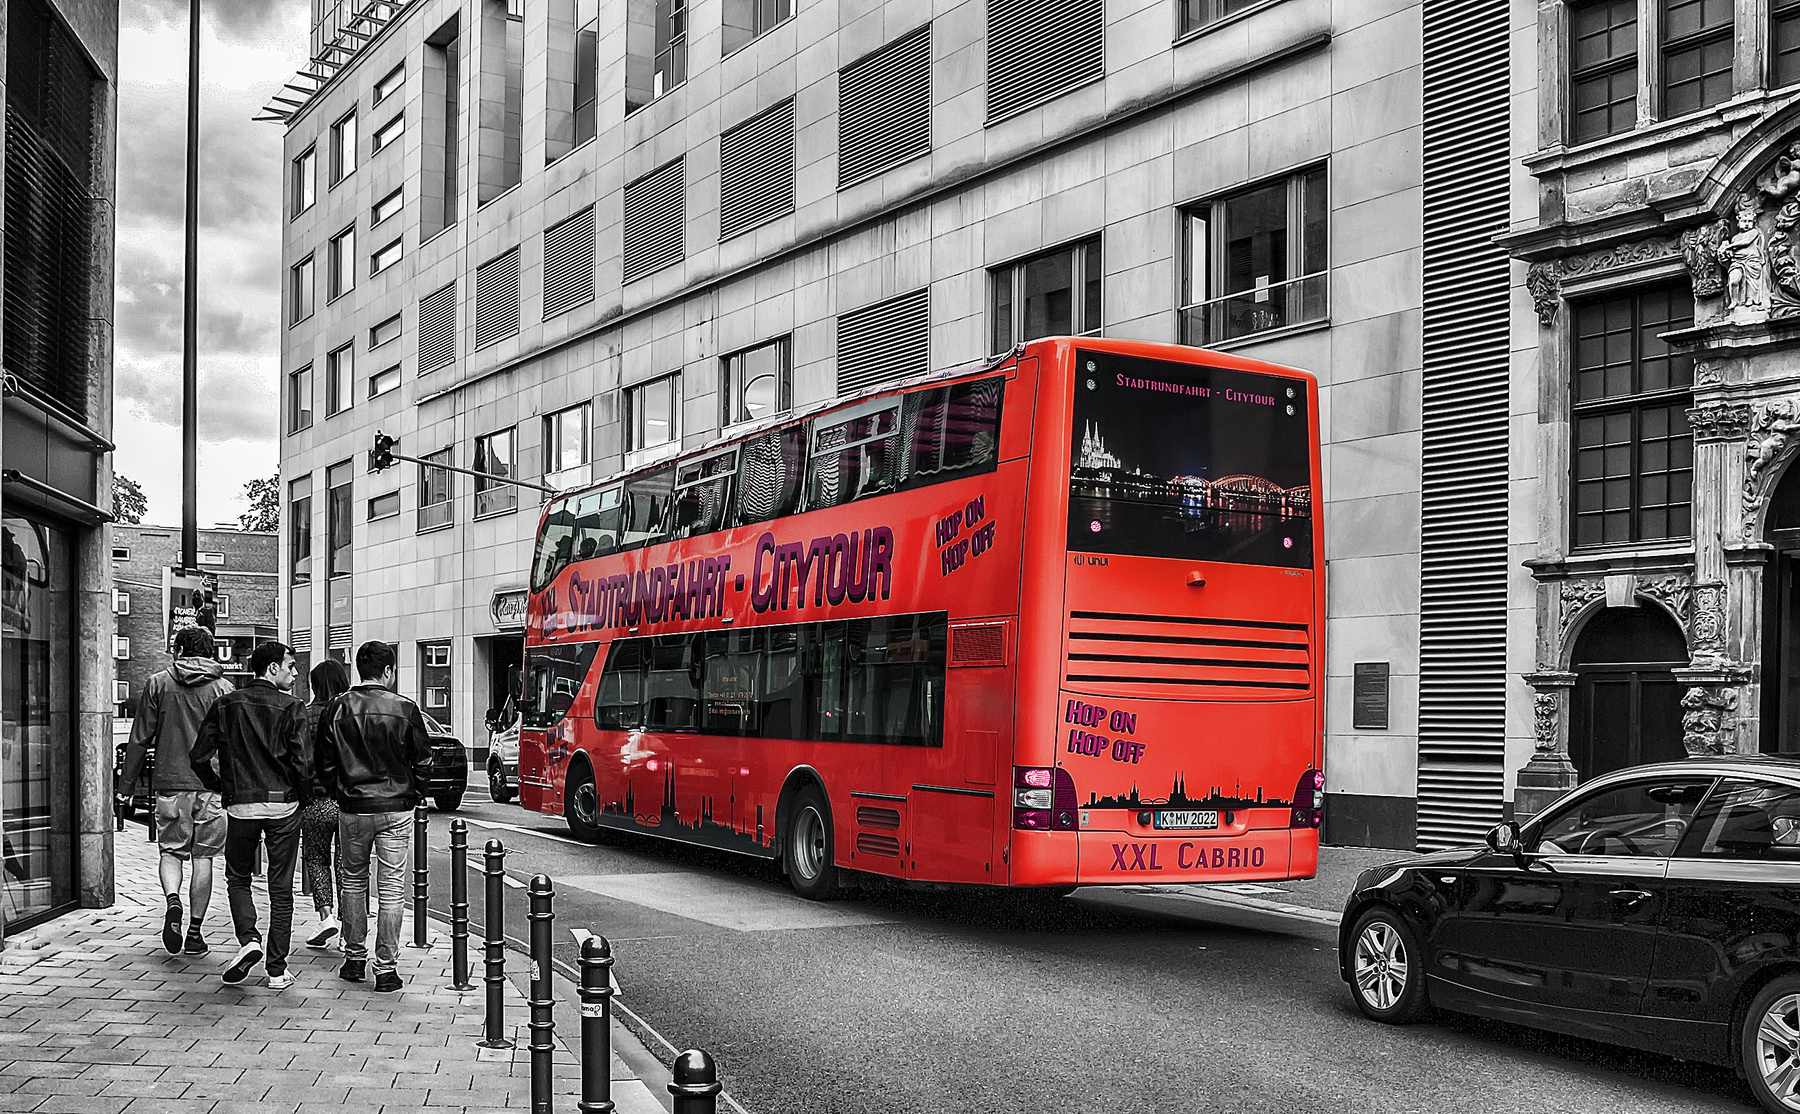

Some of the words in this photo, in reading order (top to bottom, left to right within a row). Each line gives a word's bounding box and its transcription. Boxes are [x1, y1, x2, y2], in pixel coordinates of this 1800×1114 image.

[1116, 373, 1212, 398] STADTRUNDFAHRT
[1225, 388, 1275, 406] CITYTOUR
[935, 509, 963, 549] HOP
[965, 493, 985, 529] ON
[941, 538, 969, 578] HOP
[971, 519, 996, 558] OFF
[566, 554, 732, 634] STADTRUNDFAHRT
[750, 532, 895, 614] CITYTOUR
[218, 646, 231, 661] U
[1065, 699, 1108, 729] HOP
[1109, 709, 1138, 736] ON
[1067, 728, 1110, 758] HOP
[1112, 738, 1147, 765] OFF
[1161, 812, 1169, 826] K
[1175, 812, 1189, 826] MV
[1191, 812, 1216, 826] 2022
[1110, 843, 1163, 872] XXL
[1178, 842, 1266, 870] CABRIO
